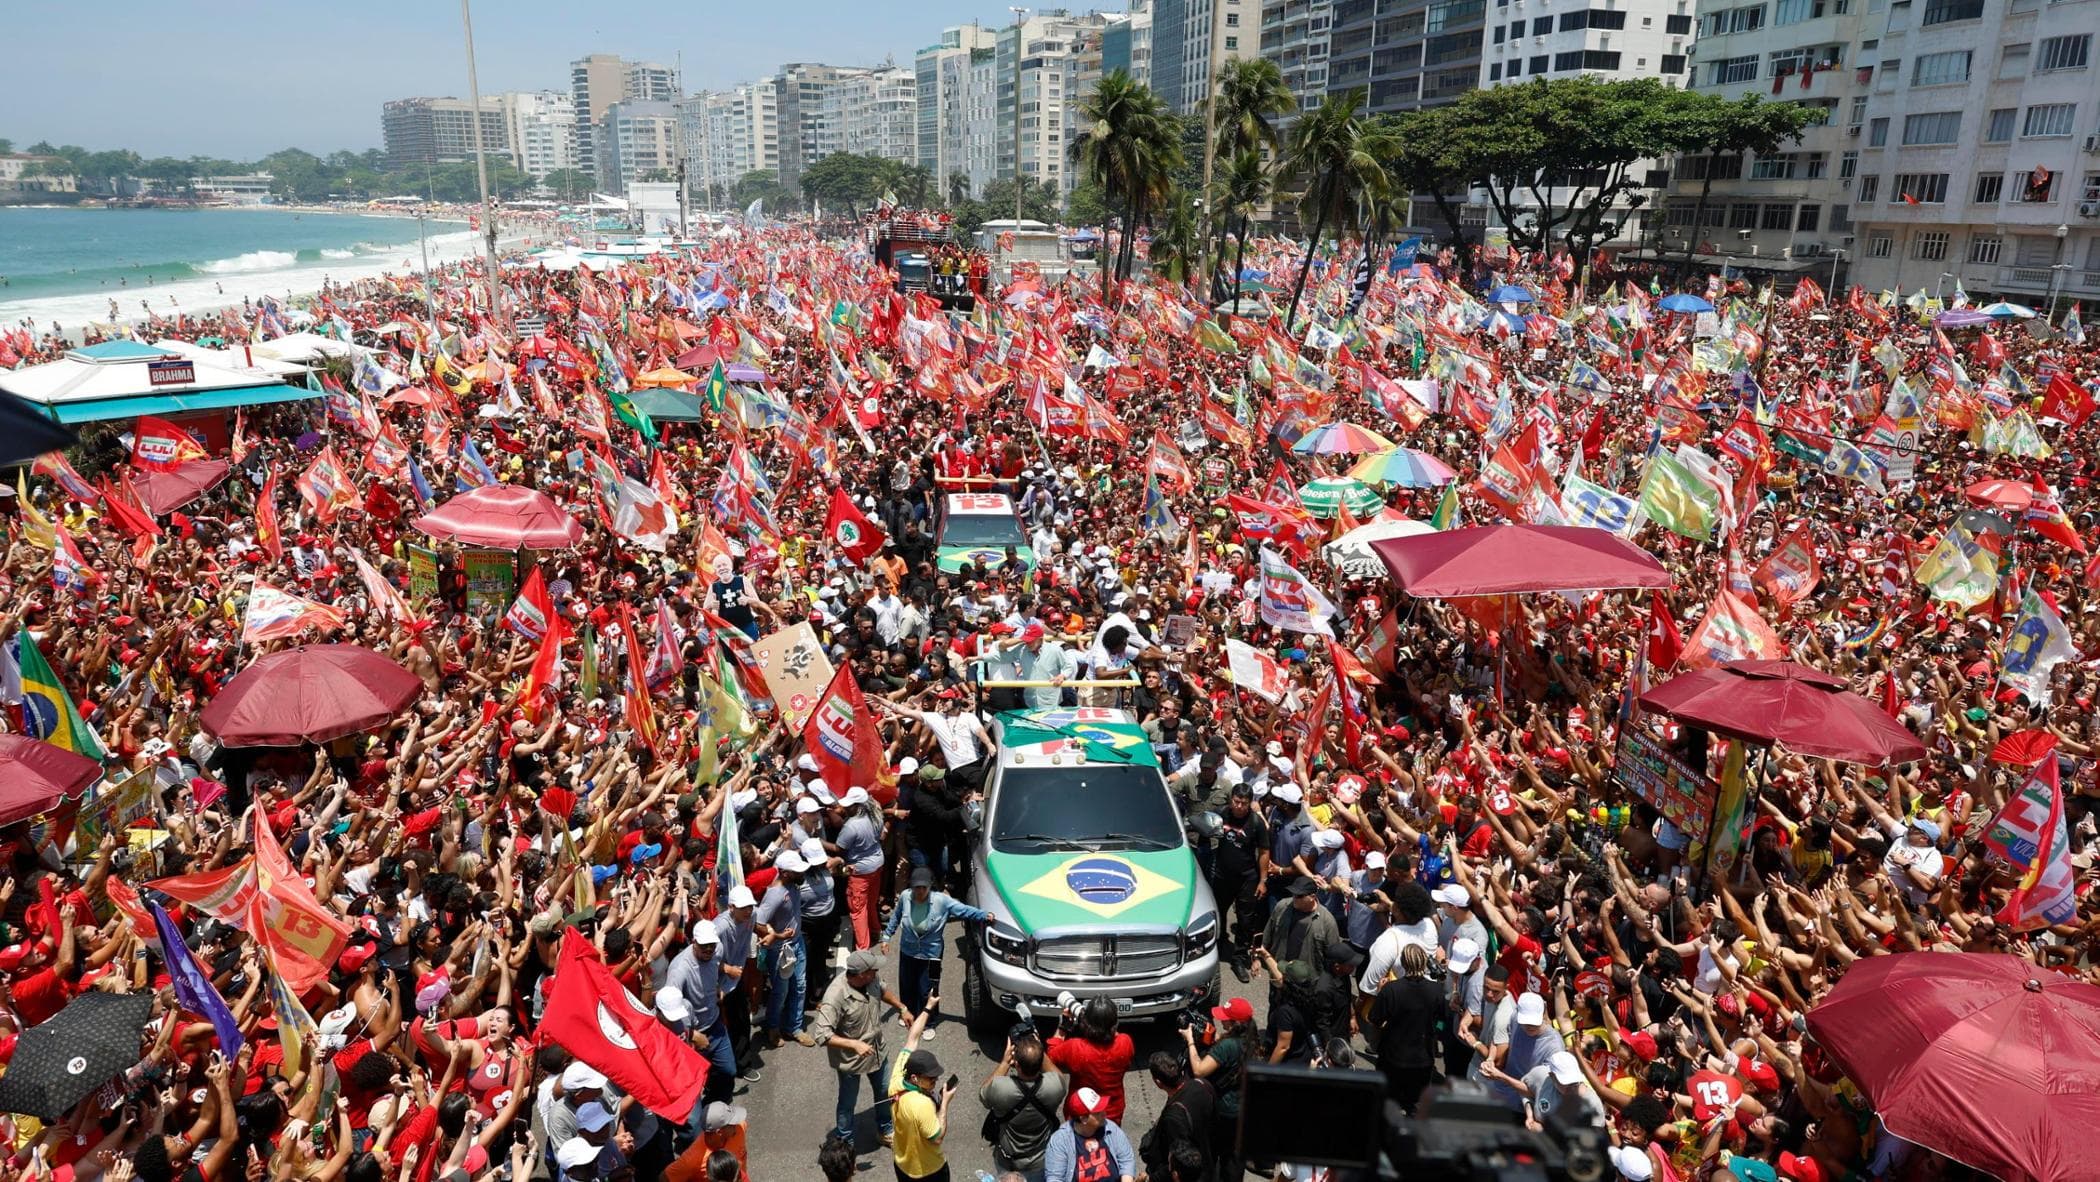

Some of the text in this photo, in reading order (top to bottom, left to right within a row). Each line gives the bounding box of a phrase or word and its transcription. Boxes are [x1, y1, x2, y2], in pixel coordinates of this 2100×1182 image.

[151, 369, 194, 382] BRAHMA
[1901, 437, 1912, 450] 60
[1206, 460, 1225, 469] LULA
[956, 497, 1004, 510] 13
[1362, 599, 1377, 612] 13
[1077, 708, 1113, 719] TE
[1633, 731, 1663, 757] DRINKS
[1670, 757, 1706, 788] BEBIDAS
[282, 907, 324, 940] 13
[73, 1059, 84, 1071] 13
[1696, 1081, 1729, 1106] 13
[1078, 1147, 1107, 1171] LU
[1078, 1162, 1111, 1182] LA
